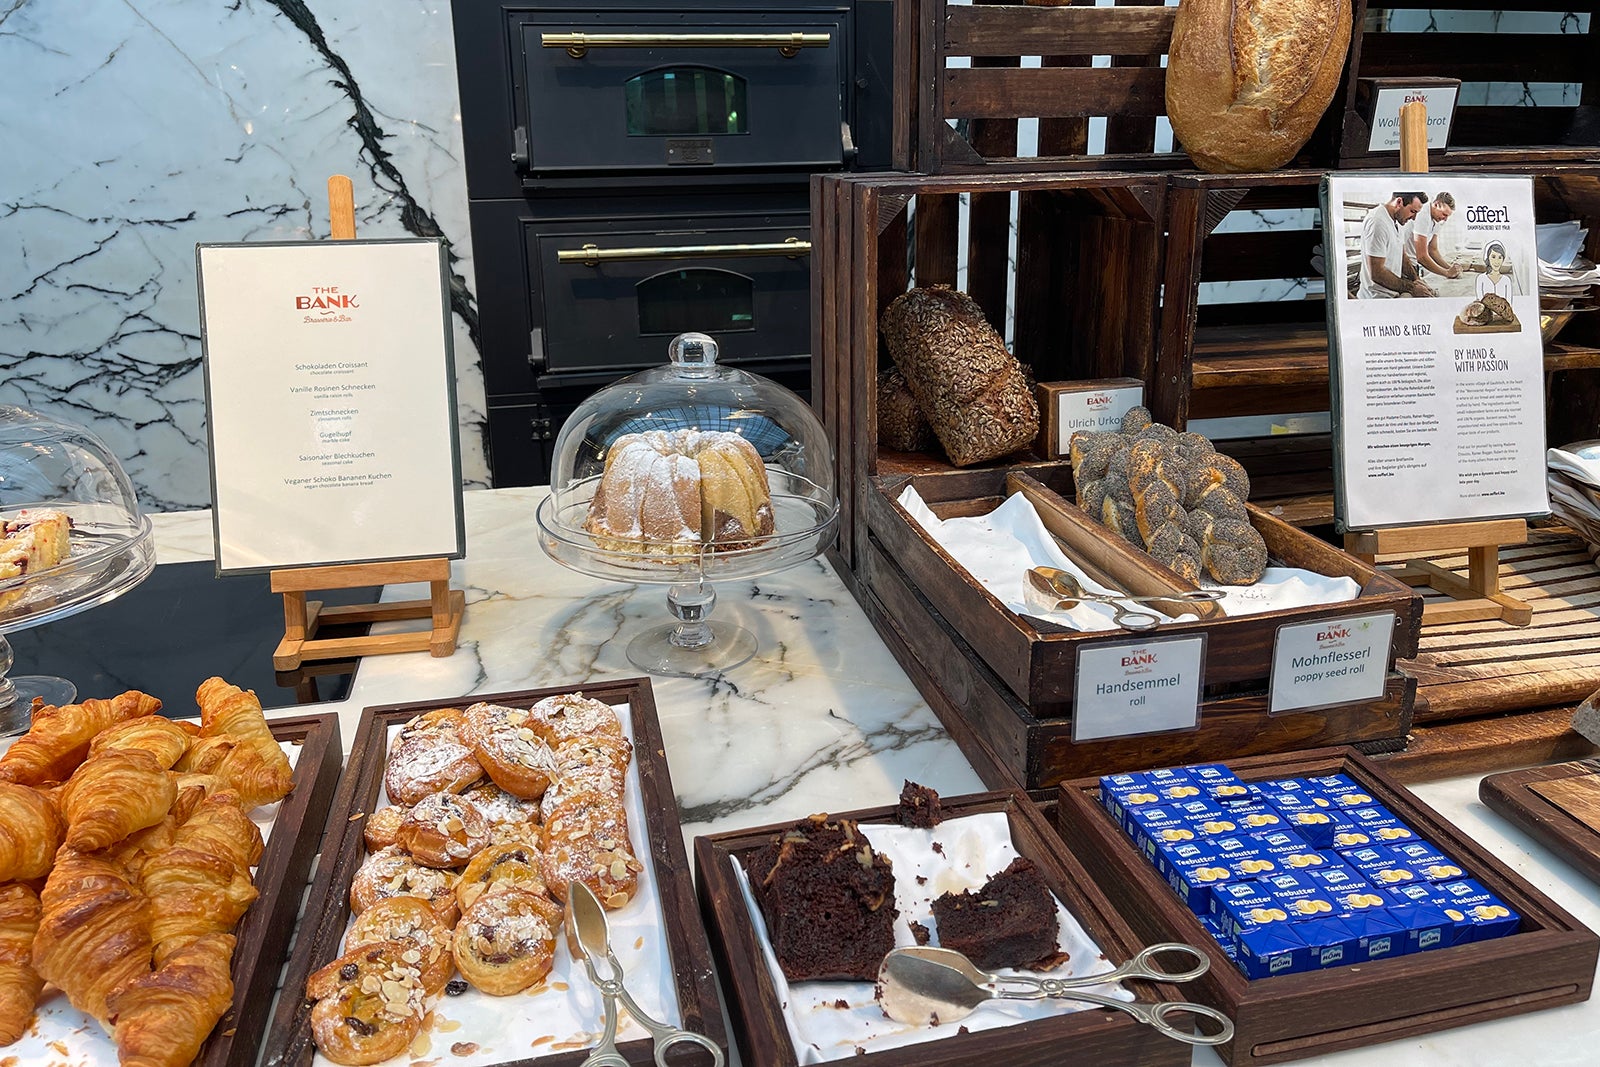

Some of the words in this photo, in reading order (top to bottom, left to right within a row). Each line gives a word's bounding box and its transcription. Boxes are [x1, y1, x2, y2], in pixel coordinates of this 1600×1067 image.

[296, 294, 360, 310] BANK
[1363, 326, 1376, 337] MIT
[1379, 325, 1401, 336] HAND
[1404, 324, 1410, 336] &
[1412, 324, 1431, 336] HERZ
[1454, 348, 1464, 360] BY
[1466, 348, 1487, 360] HAND
[1489, 348, 1496, 359] &
[295, 362, 336, 370] Schokoladen
[1455, 361, 1474, 372] WITH
[1477, 360, 1508, 372] PASSION
[1086, 396, 1112, 406] BANK
[310, 408, 358, 416] Zimtschnecken
[1068, 418, 1096, 428] Ulrich
[298, 454, 332, 462] Saisonaler
[334, 452, 375, 460] Blechkuchen
[284, 478, 312, 486] Veganer
[338, 474, 366, 482] Bananen
[368, 472, 392, 480] Kuchen
[1316, 628, 1351, 641] BANK
[1132, 648, 1146, 656] THE
[1292, 646, 1370, 668] Mohnflesserl
[1121, 653, 1158, 667] BANK
[1294, 672, 1324, 684] poppy
[1326, 666, 1348, 678] seed
[1350, 664, 1364, 674] roll
[1096, 673, 1180, 695] Handsemmel
[1130, 696, 1146, 706] roll
[1152, 778, 1188, 786] Teebutter
[1111, 784, 1148, 792] Teebutter
[1322, 786, 1357, 794] Teebutter
[1227, 805, 1264, 814] Teebutter
[1184, 812, 1222, 820] Teebutter
[1143, 820, 1182, 828] Teebutter
[1359, 818, 1396, 827] Teebutter
[1219, 849, 1260, 858] Teebutter
[1267, 844, 1307, 854] Teebutter
[1176, 856, 1216, 866] Teebutter
[1358, 860, 1396, 870] Teebutter
[1406, 856, 1444, 866] Teebutter
[1324, 882, 1366, 892] Teebutter
[1273, 888, 1316, 898] Teebutter
[1228, 896, 1272, 906] Teebutter
[1452, 894, 1490, 904] Teebutter
